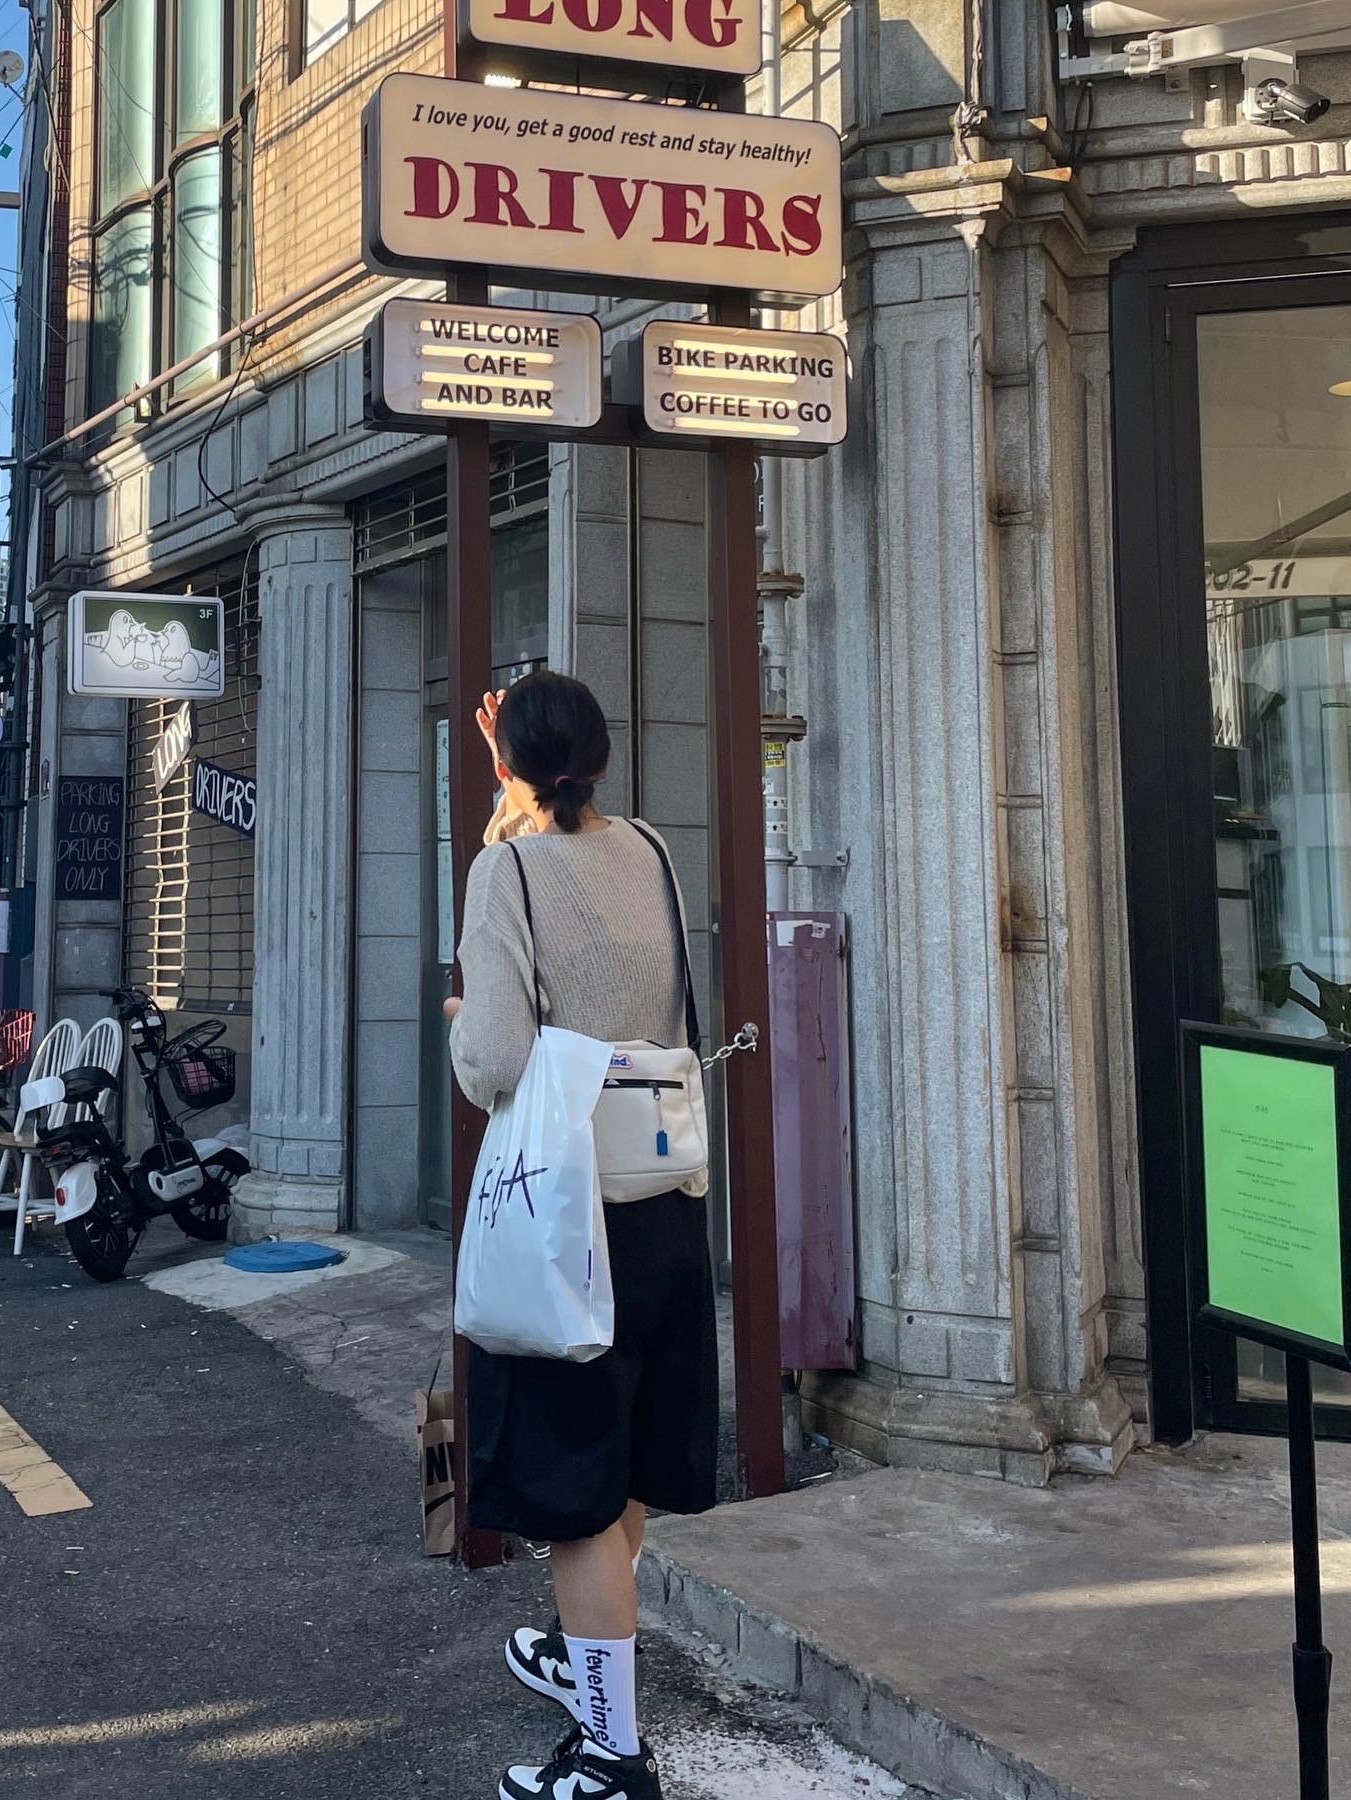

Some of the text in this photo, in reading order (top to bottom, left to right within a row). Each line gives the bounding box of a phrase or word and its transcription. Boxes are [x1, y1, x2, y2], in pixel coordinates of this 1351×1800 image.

[412, 104, 812, 167] I love you, get a good rest and stay healthy!
[404, 156, 822, 256] DRIVERS
[430, 318, 560, 348] WELCOME
[463, 353, 527, 376] CAFE
[658, 346, 833, 378] BIKE PARKING
[437, 383, 553, 410] AND BAR
[660, 392, 832, 423] COFFEE TO GO
[199, 609, 213, 619] 3F
[157, 701, 192, 780] LONG
[61, 781, 120, 806] PARKING
[196, 762, 257, 831] DRIVERS
[69, 811, 111, 834] LONG
[57, 838, 120, 862] DRIVERS
[65, 866, 109, 892] ONLY
